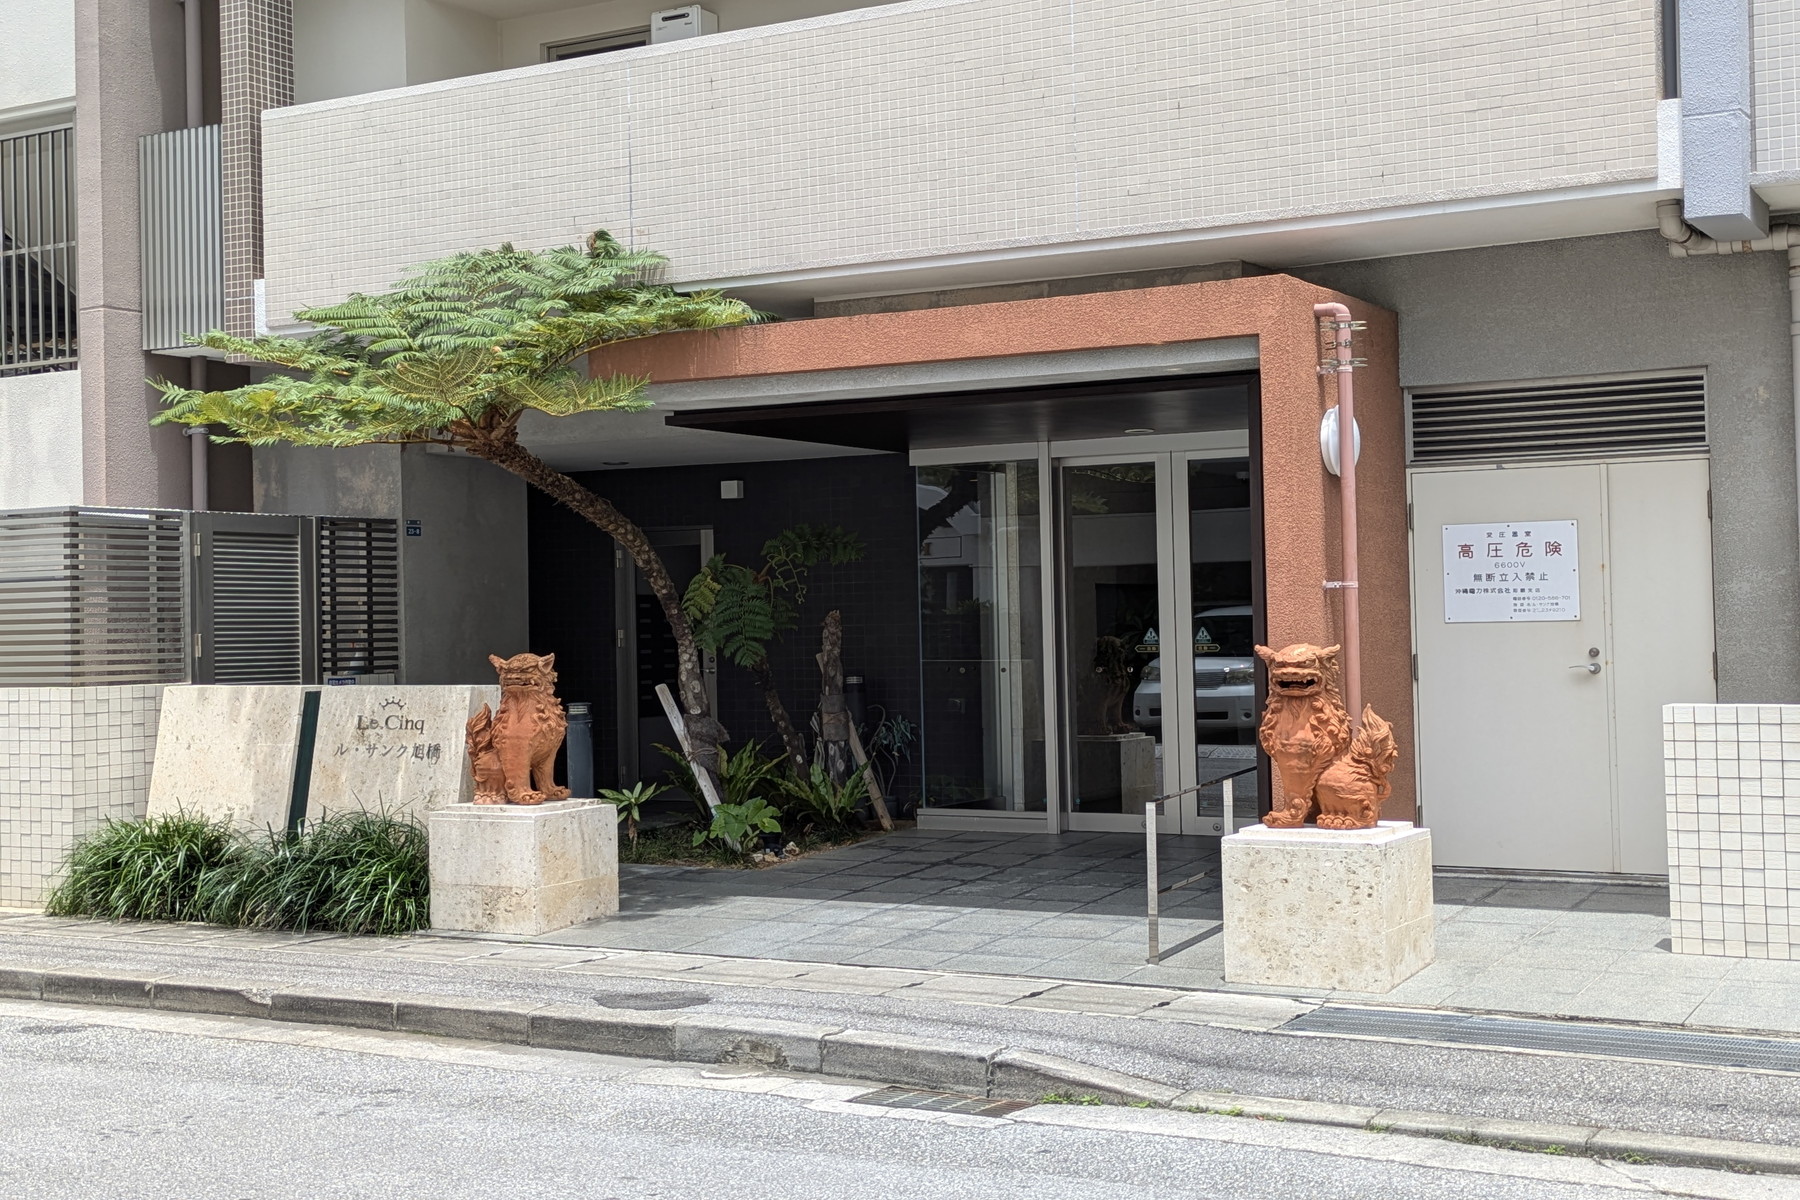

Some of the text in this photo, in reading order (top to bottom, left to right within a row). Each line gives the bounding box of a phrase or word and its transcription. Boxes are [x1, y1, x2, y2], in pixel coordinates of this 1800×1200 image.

[1457, 540, 1563, 560] 高圧危険
[1494, 561, 1526, 569] 6600V
[1473, 572, 1549, 583] 無断立入禁止
[356, 714, 426, 736] Le Cinq
[333, 742, 441, 766] ル・サンク旭橋
